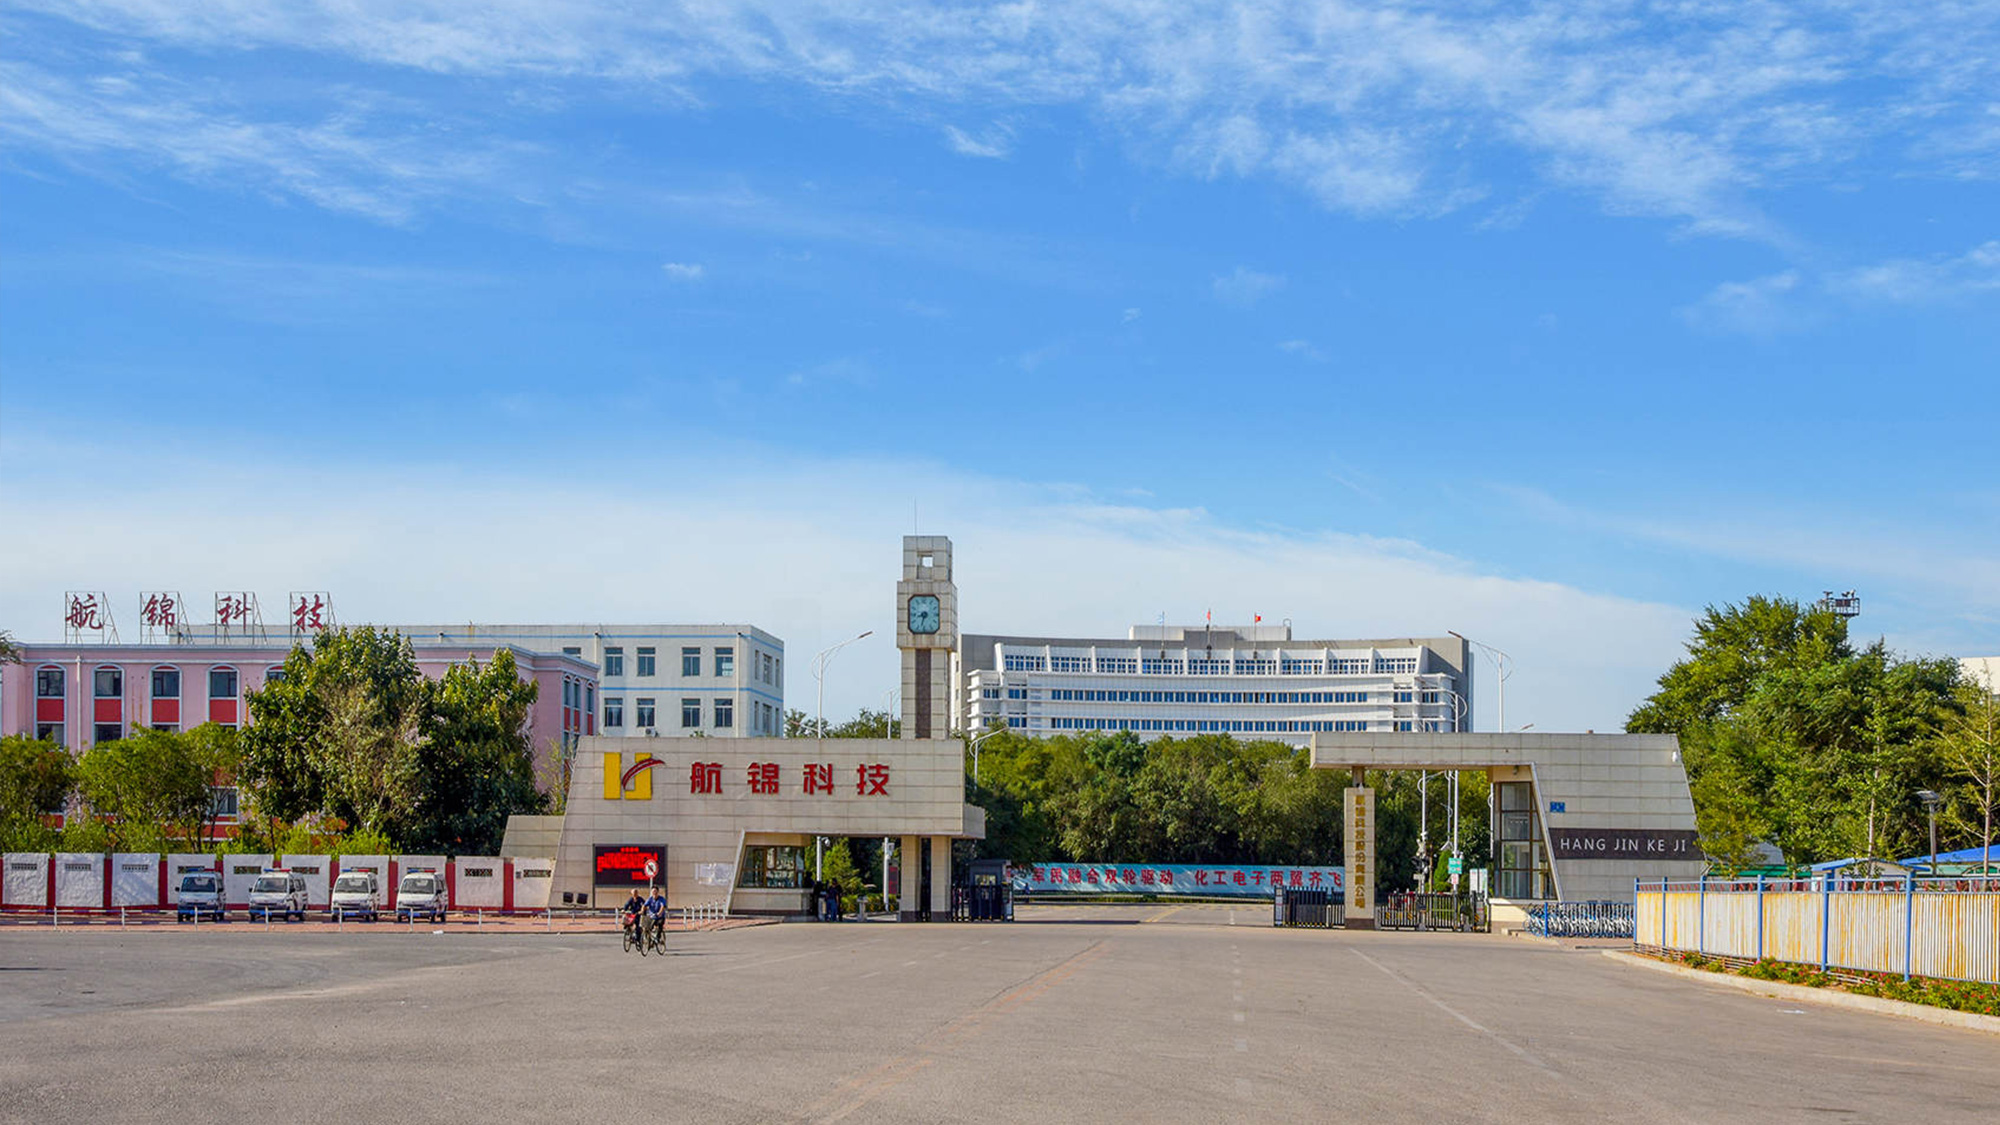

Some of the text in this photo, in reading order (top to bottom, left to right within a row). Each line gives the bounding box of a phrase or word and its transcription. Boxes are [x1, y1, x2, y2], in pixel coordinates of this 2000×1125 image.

[690, 762, 890, 796] 航锦科技
[1560, 838, 1686, 852] HANG JIN KE JI
